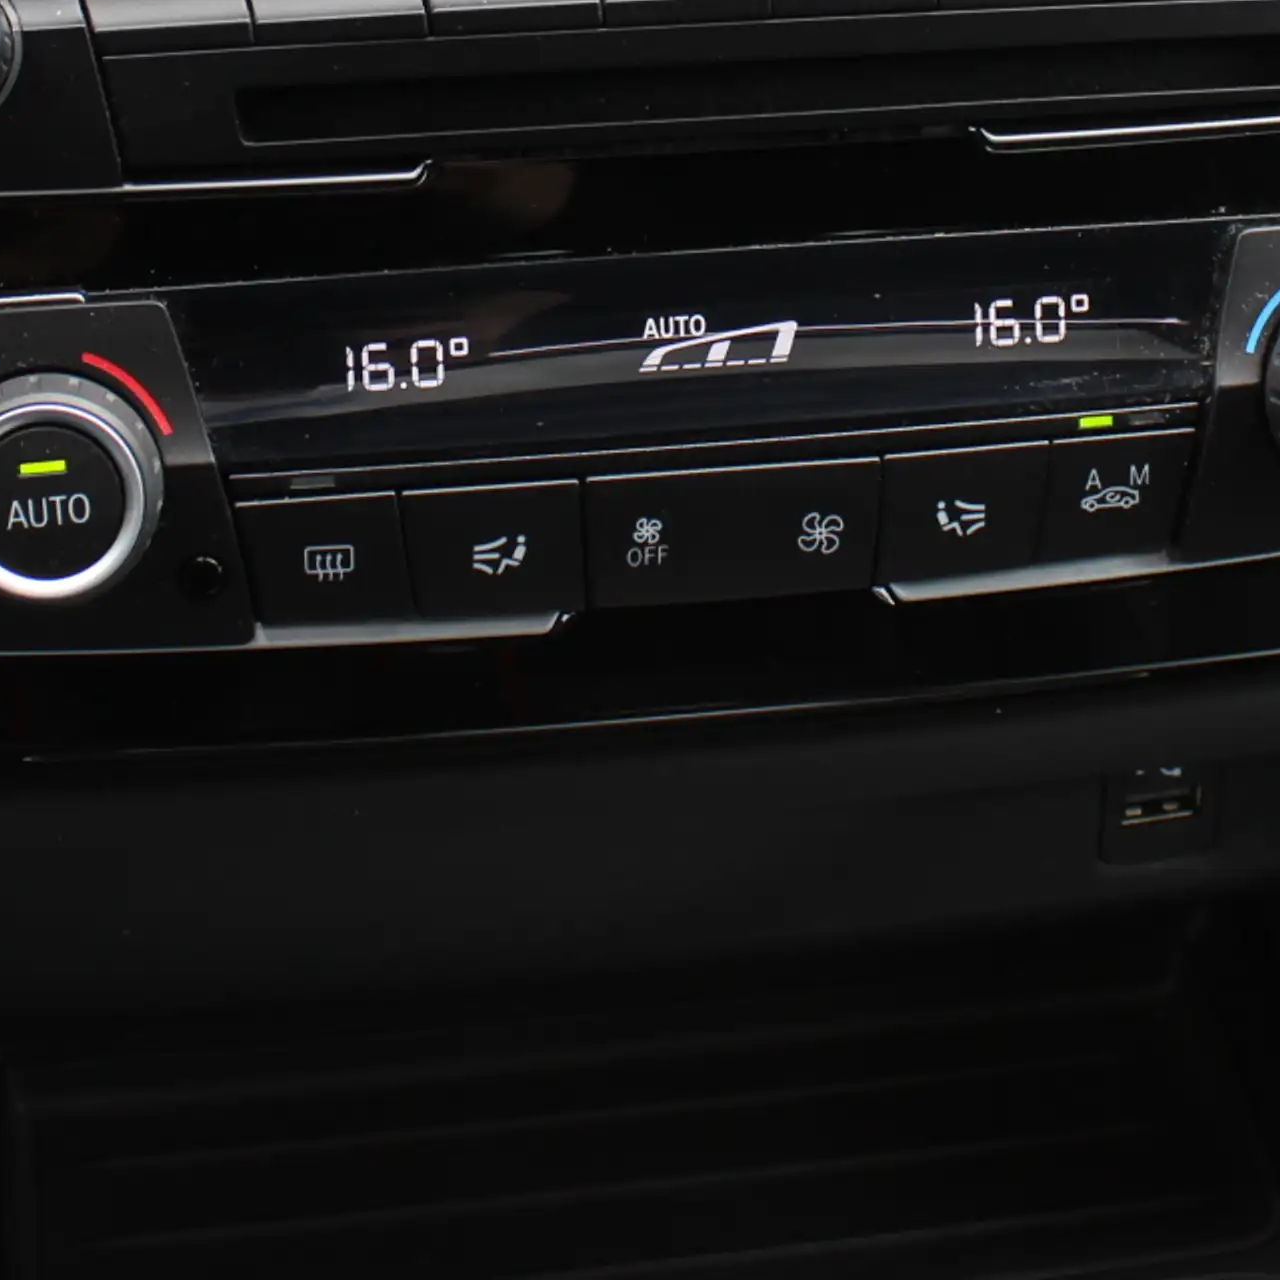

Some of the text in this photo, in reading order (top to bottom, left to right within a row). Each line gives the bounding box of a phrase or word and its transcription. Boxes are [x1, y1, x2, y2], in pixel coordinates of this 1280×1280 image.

[643, 314, 707, 338] AUTO
[1085, 463, 1150, 490] A M
[7, 493, 91, 530] AUTO
[626, 545, 670, 568] OFF
